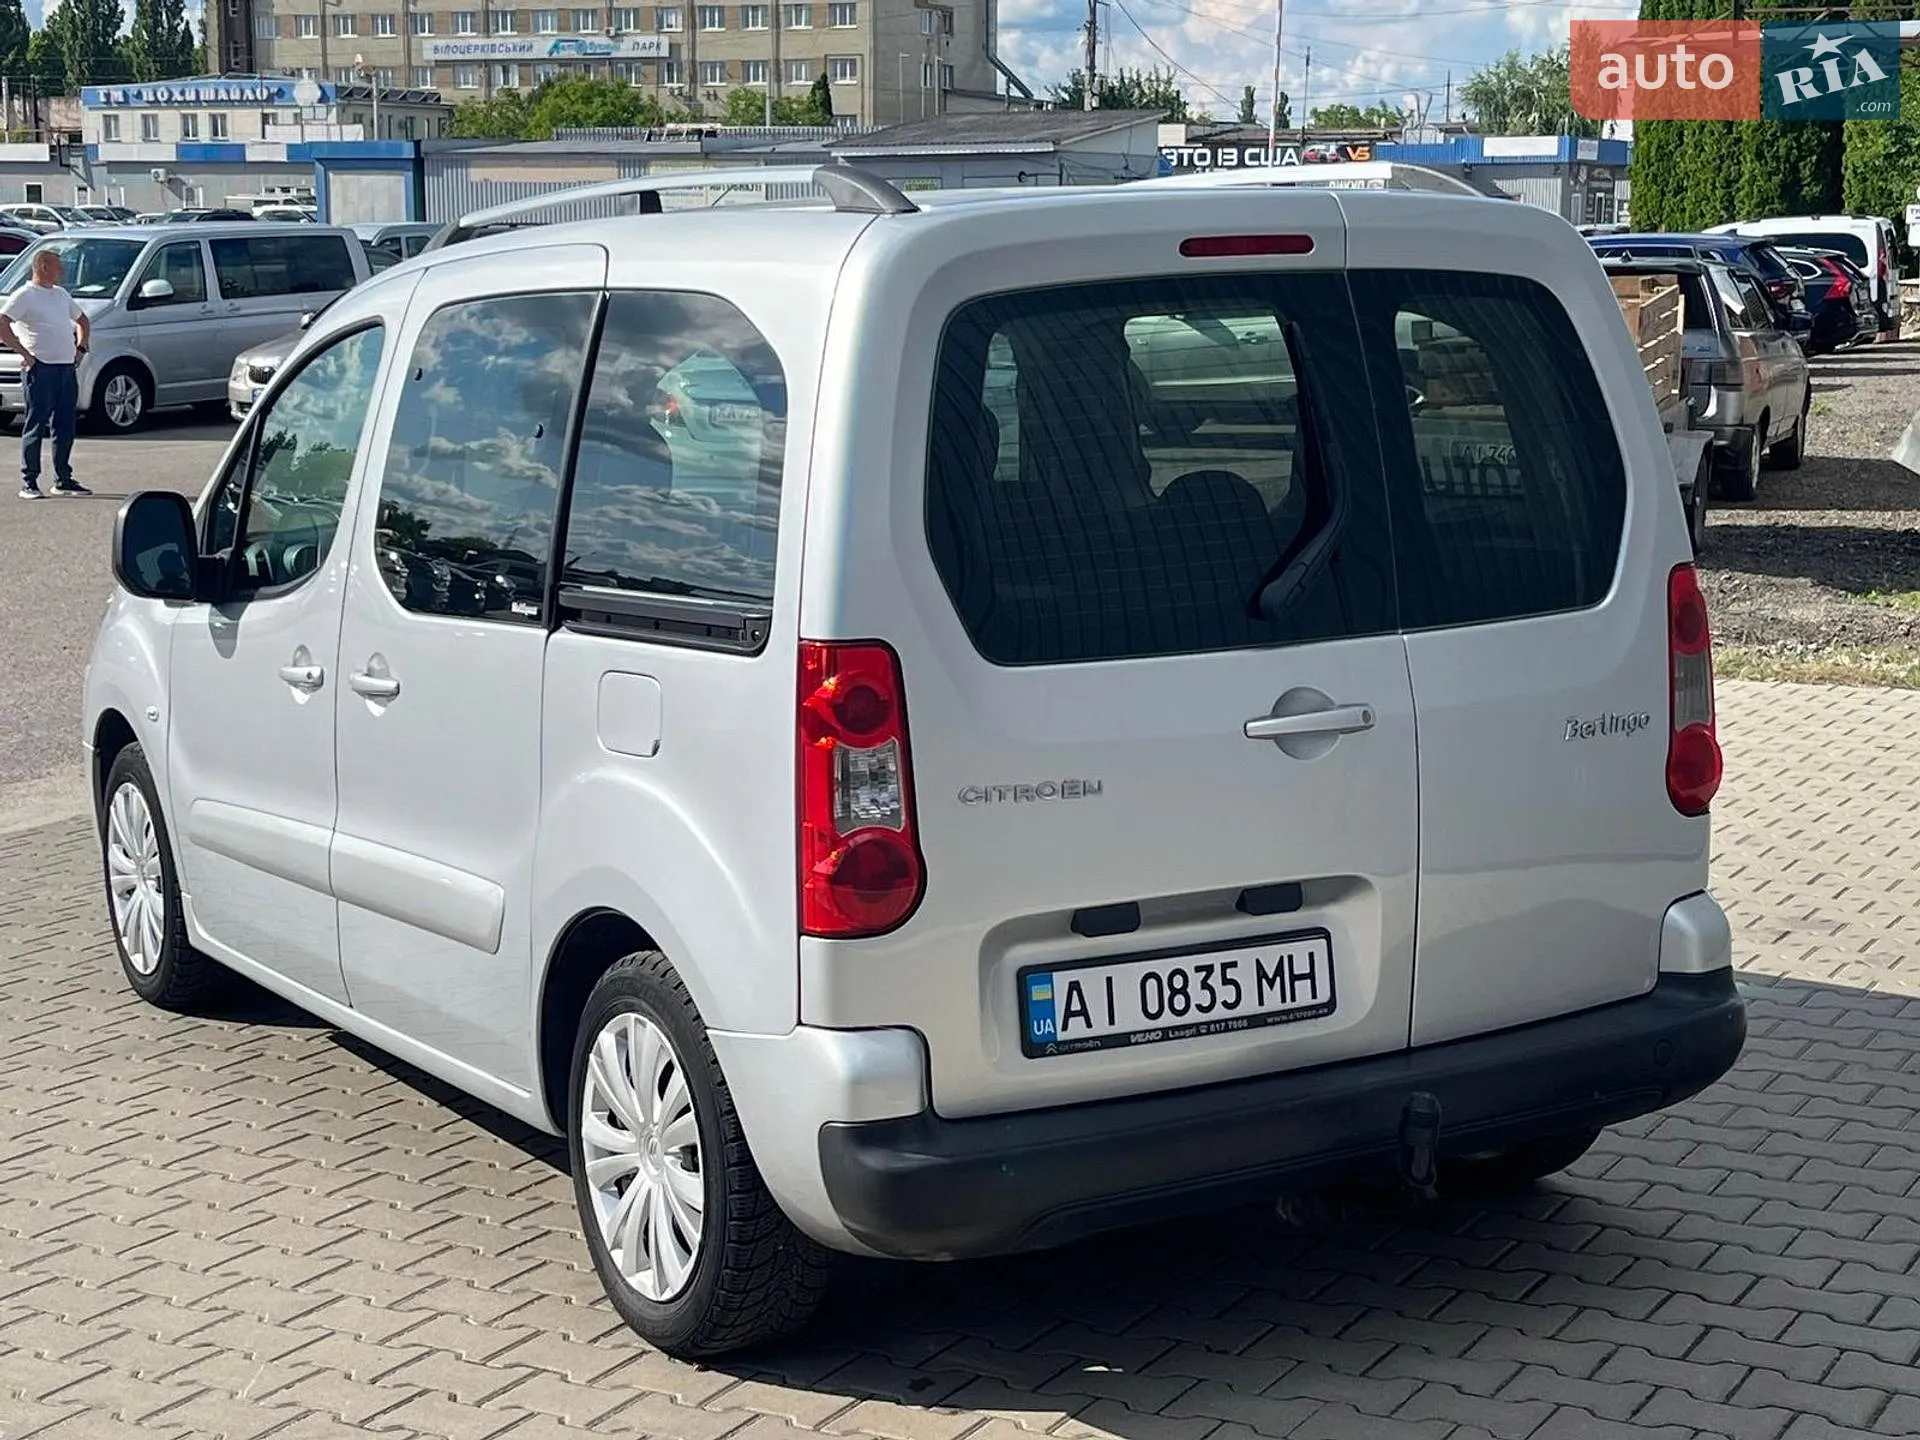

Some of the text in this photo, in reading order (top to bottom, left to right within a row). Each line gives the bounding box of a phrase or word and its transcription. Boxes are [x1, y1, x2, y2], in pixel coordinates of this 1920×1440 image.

[632, 41, 662, 51] ПАРК
[1564, 711, 1650, 740] Berlingo
[1140, 960, 1242, 1021] 0835
[1255, 951, 1318, 1006] MH
[1033, 1018, 1055, 1036] UA
